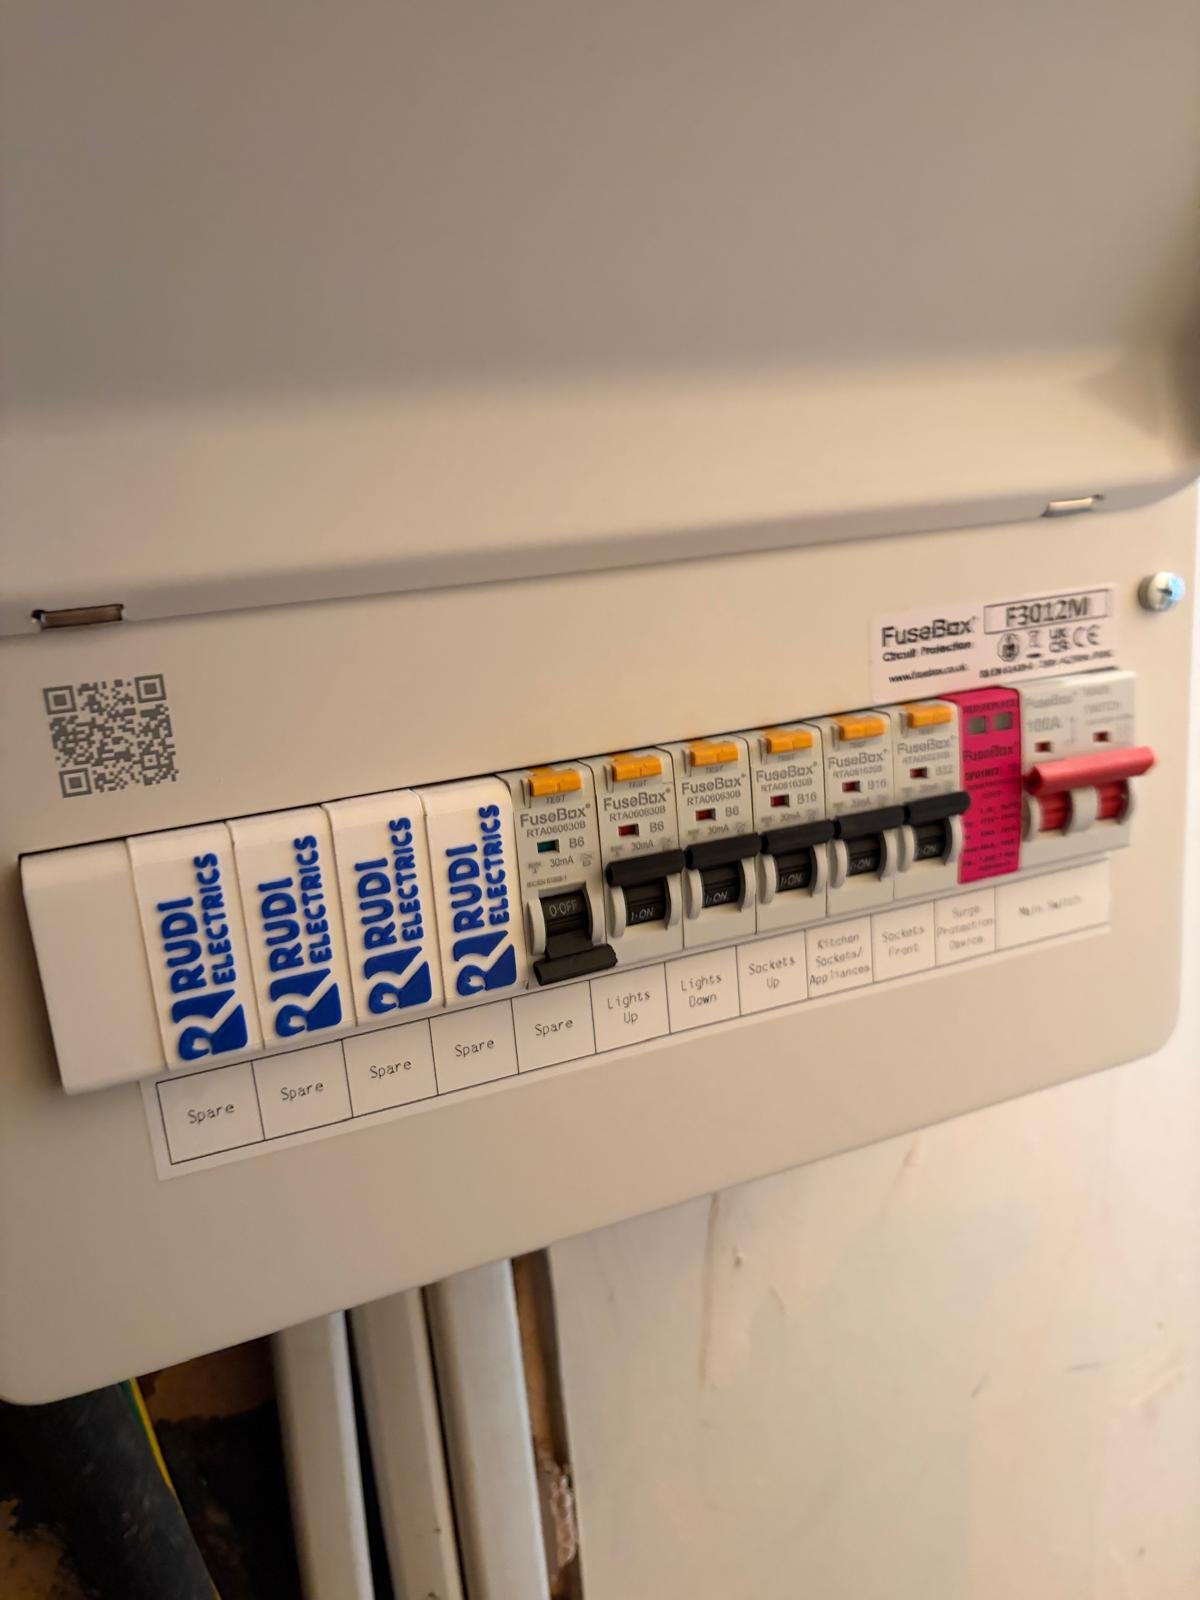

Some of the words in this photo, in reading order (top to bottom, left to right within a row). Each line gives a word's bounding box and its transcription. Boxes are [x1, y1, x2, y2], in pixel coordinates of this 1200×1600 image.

[1005, 597, 1089, 627] F3012M
[881, 618, 973, 647] FuseBox
[756, 764, 813, 782] FuseBox
[681, 777, 742, 795] FuseBox
[603, 791, 667, 811] FuseBox
[797, 792, 817, 805] B16
[519, 807, 587, 828] FuseBox
[725, 806, 740, 817] B6
[526, 820, 586, 838] RTA060630B
[649, 821, 665, 833] B6
[569, 836, 585, 848] B6
[477, 804, 510, 926] ELECTRICS
[549, 855, 575, 868] 30mA
[387, 816, 424, 942] ELECTRICS
[445, 843, 485, 934] RUDI
[292, 834, 332, 965] ELECTRICS
[354, 857, 398, 950] RUDI
[192, 852, 236, 986] ELECTRICS
[257, 876, 305, 973] RUDI
[816, 933, 860, 951] Kitchen
[881, 924, 925, 943] Sockets
[156, 896, 207, 994] RUDI
[748, 955, 796, 976] Sockets
[815, 947, 863, 968] Sockets/
[680, 974, 722, 993] Lights
[766, 978, 781, 990] Up
[809, 965, 871, 986] Appliances
[607, 989, 651, 1010] Lights
[689, 993, 717, 1008] Down
[534, 1018, 574, 1038] Spare
[623, 1012, 639, 1025] Up
[454, 1038, 496, 1058] Spare
[369, 1059, 413, 1080] Spare
[280, 1081, 325, 1102] Spare
[187, 1103, 235, 1125] Spare
